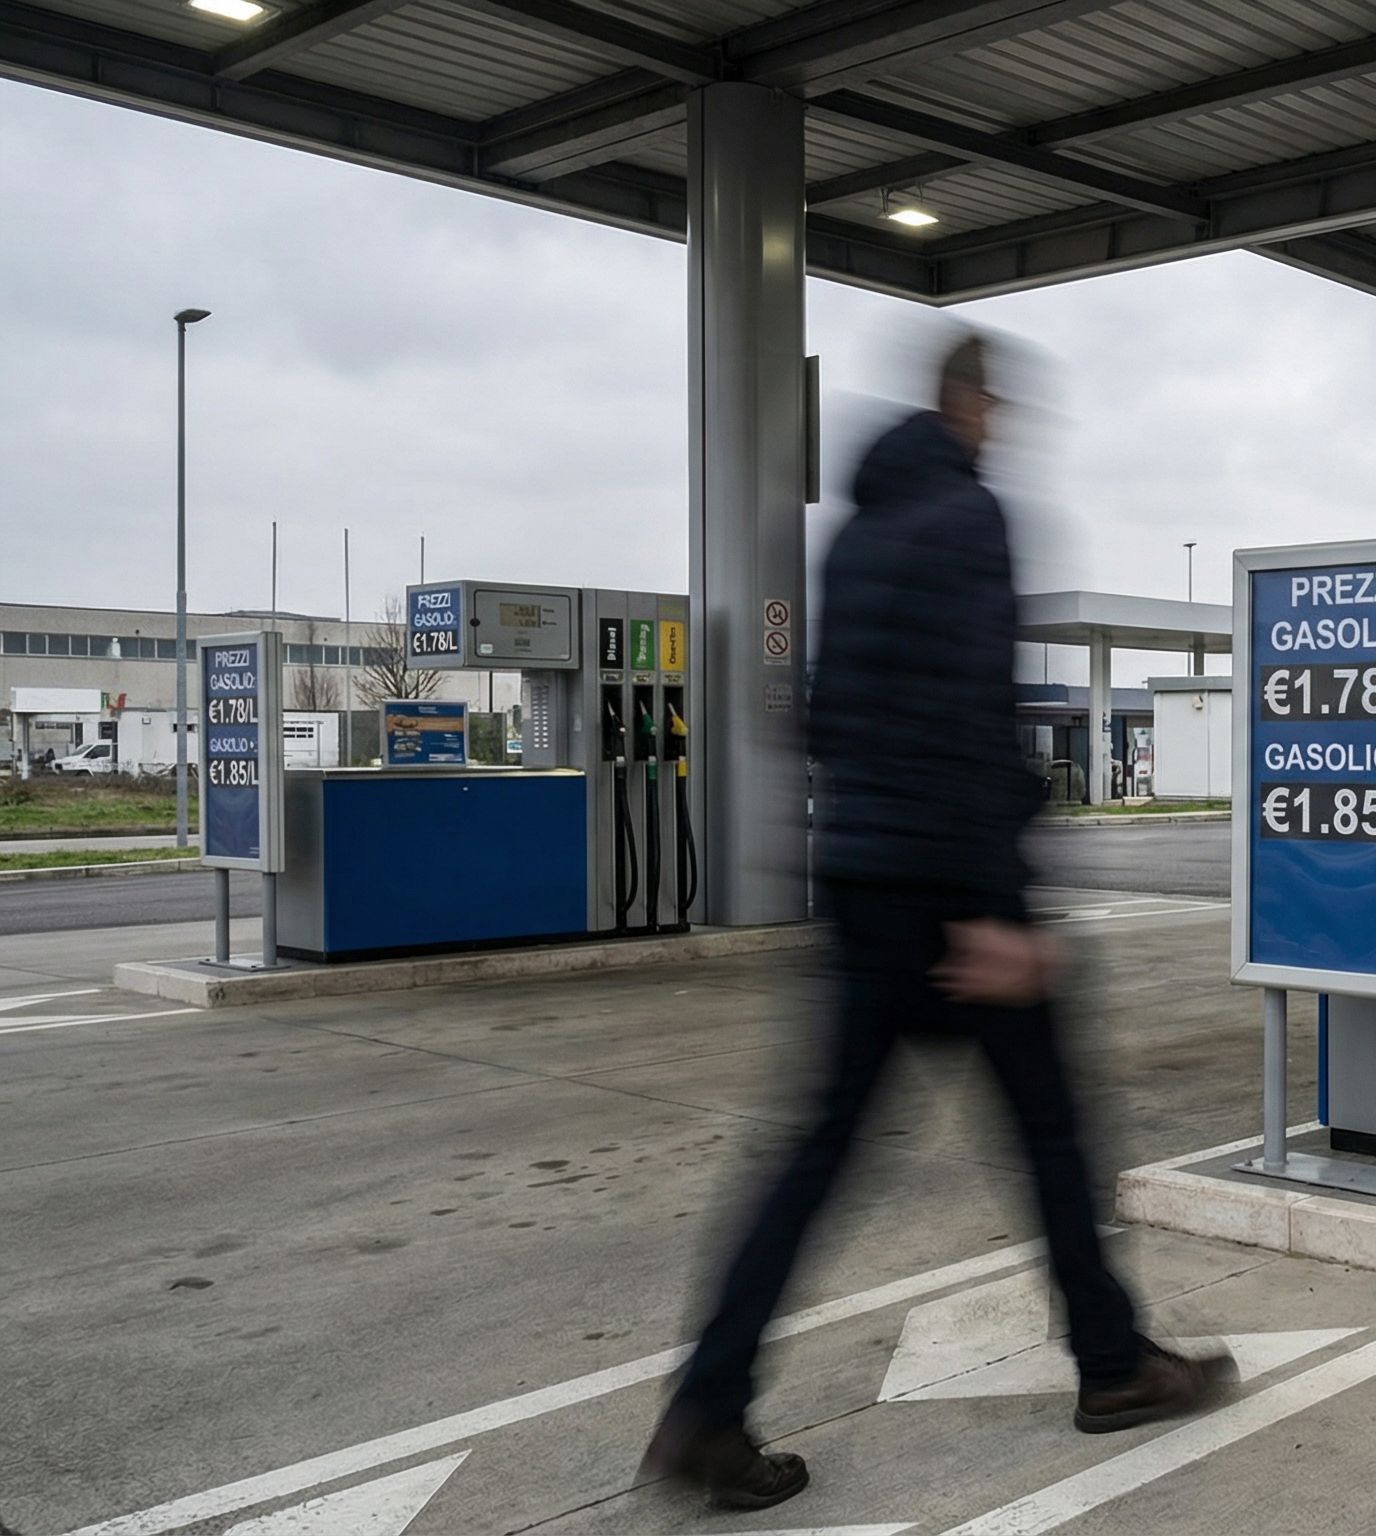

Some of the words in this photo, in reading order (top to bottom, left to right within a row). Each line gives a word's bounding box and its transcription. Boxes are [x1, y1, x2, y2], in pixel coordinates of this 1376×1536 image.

[413, 631, 458, 653] €1.78/L
[215, 650, 250, 668] PREZZI
[208, 698, 259, 724] €1.78/L
[209, 759, 260, 786] €1.85/L
